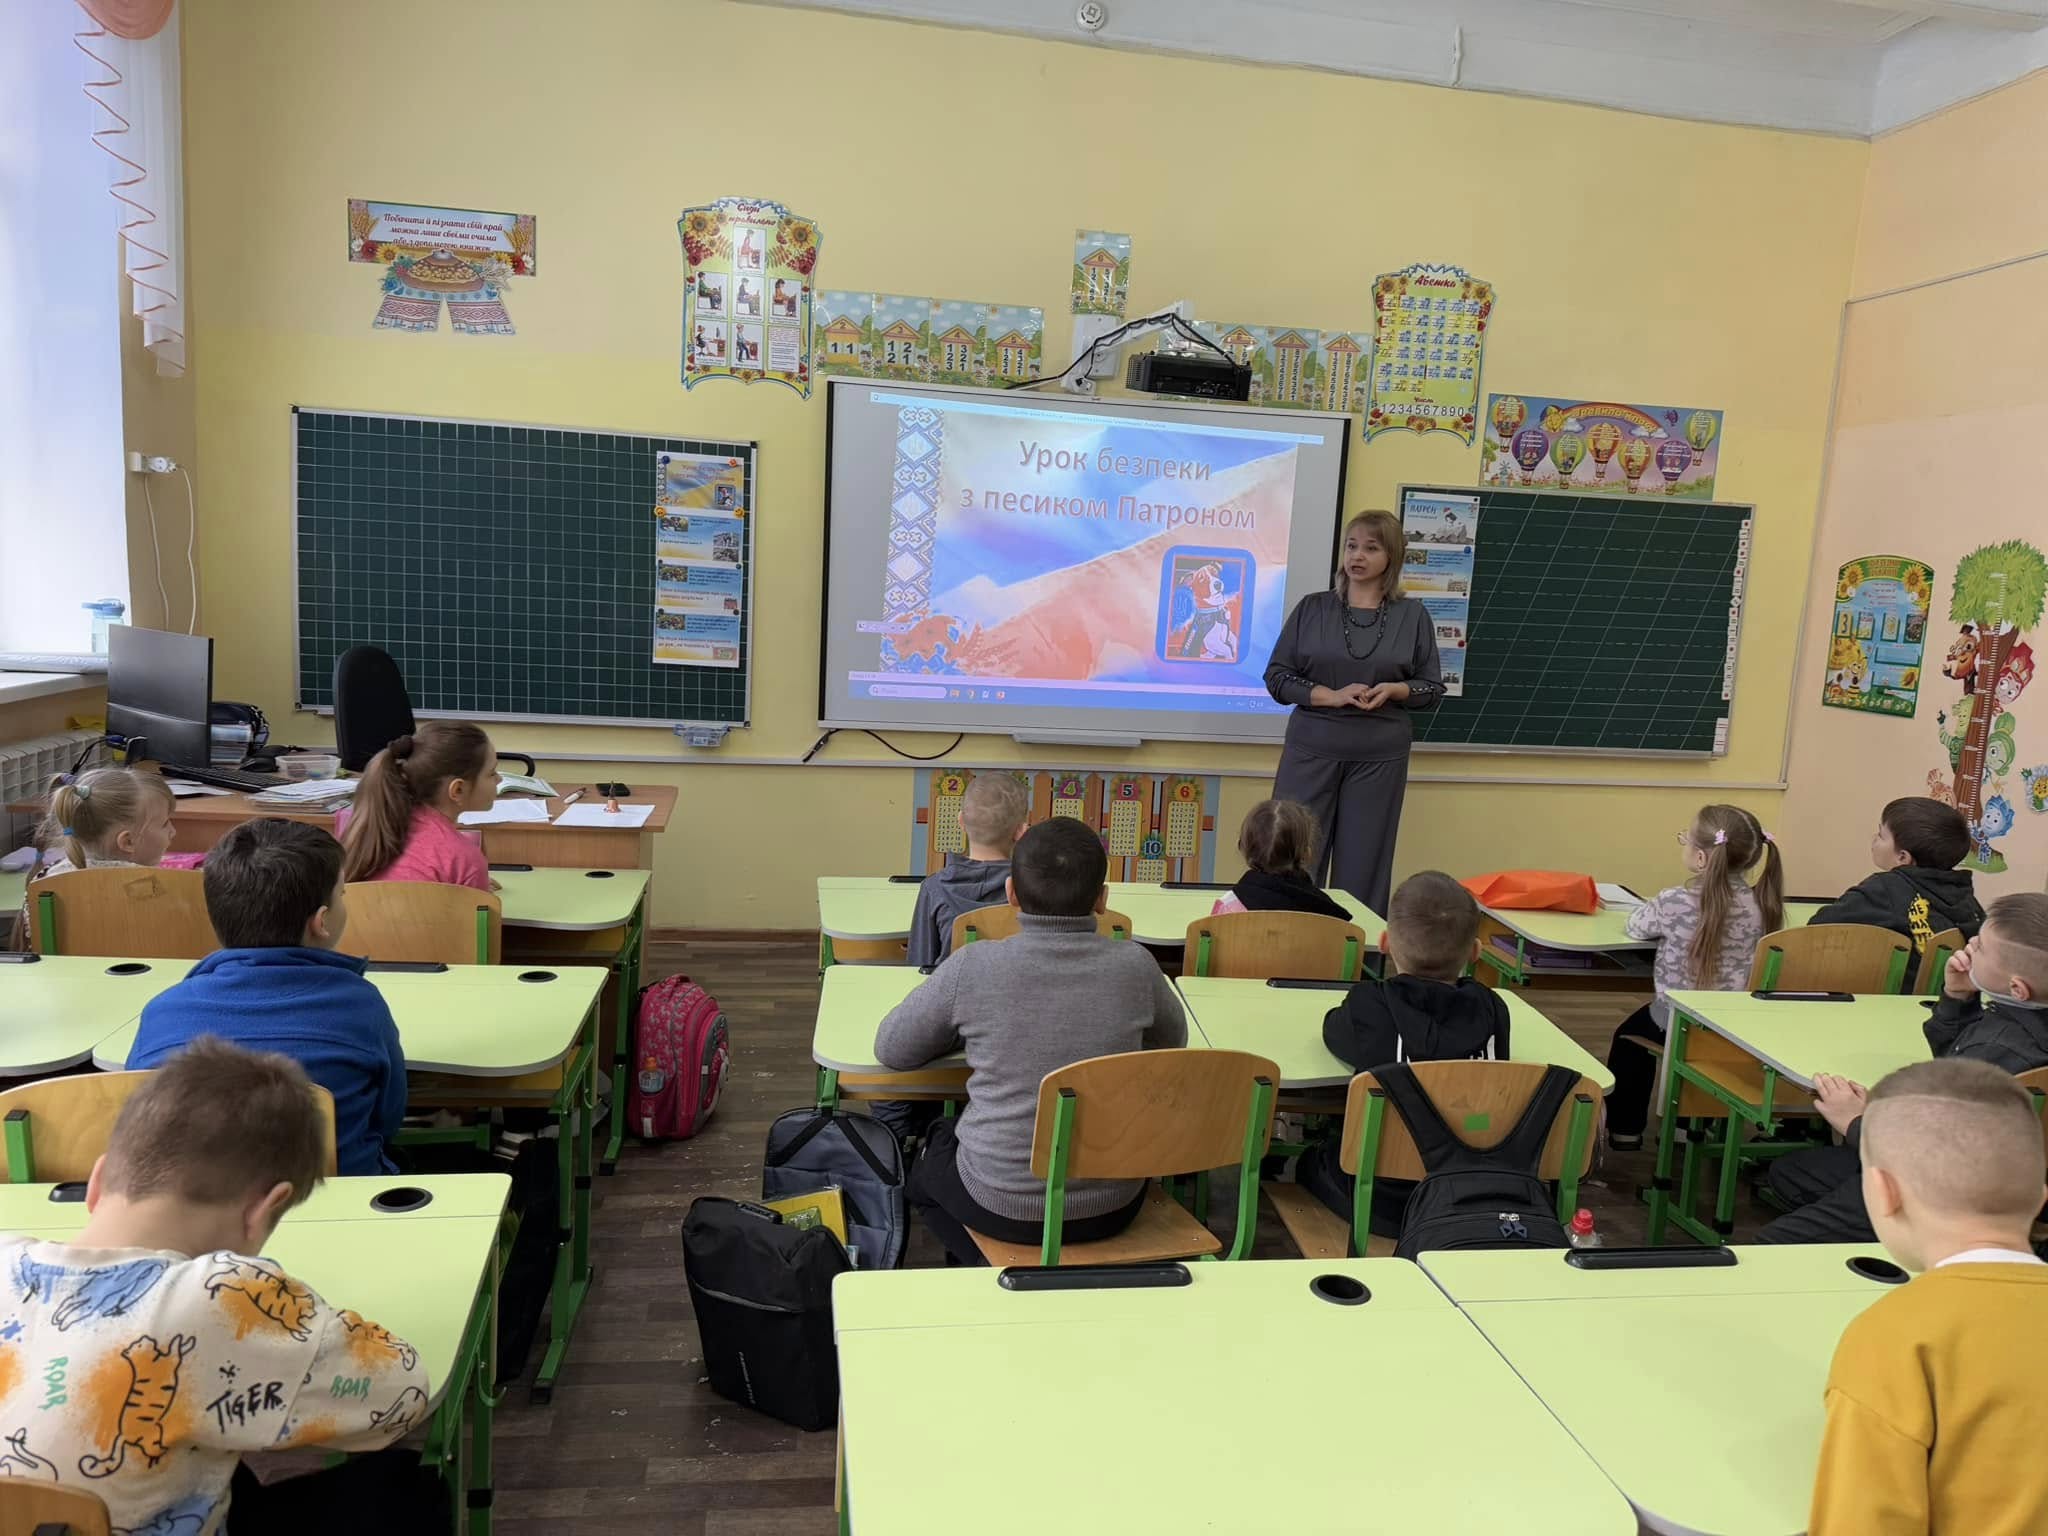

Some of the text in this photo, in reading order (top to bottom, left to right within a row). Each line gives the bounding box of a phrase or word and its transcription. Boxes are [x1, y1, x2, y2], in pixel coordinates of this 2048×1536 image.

[483, 223, 503, 232] край
[1415, 275, 1456, 288] Абетка
[831, 342, 853, 354] 1 1
[888, 340, 912, 352] 1 2
[947, 344, 967, 353] 1 3
[888, 353, 909, 365] 2 1
[947, 353, 967, 362] 2 2
[946, 362, 965, 371] 3 1
[1019, 440, 1211, 481] Урок безпеки
[960, 488, 1255, 530] з песиком Патроном
[948, 778, 957, 791] 2
[1064, 781, 1076, 796] 4
[1121, 784, 1132, 797] 5
[1180, 786, 1190, 797] 6
[1144, 840, 1161, 856] 10
[38, 1356, 69, 1411] ROAR
[331, 1374, 372, 1398] ROAR
[205, 1380, 286, 1434] TIGER
